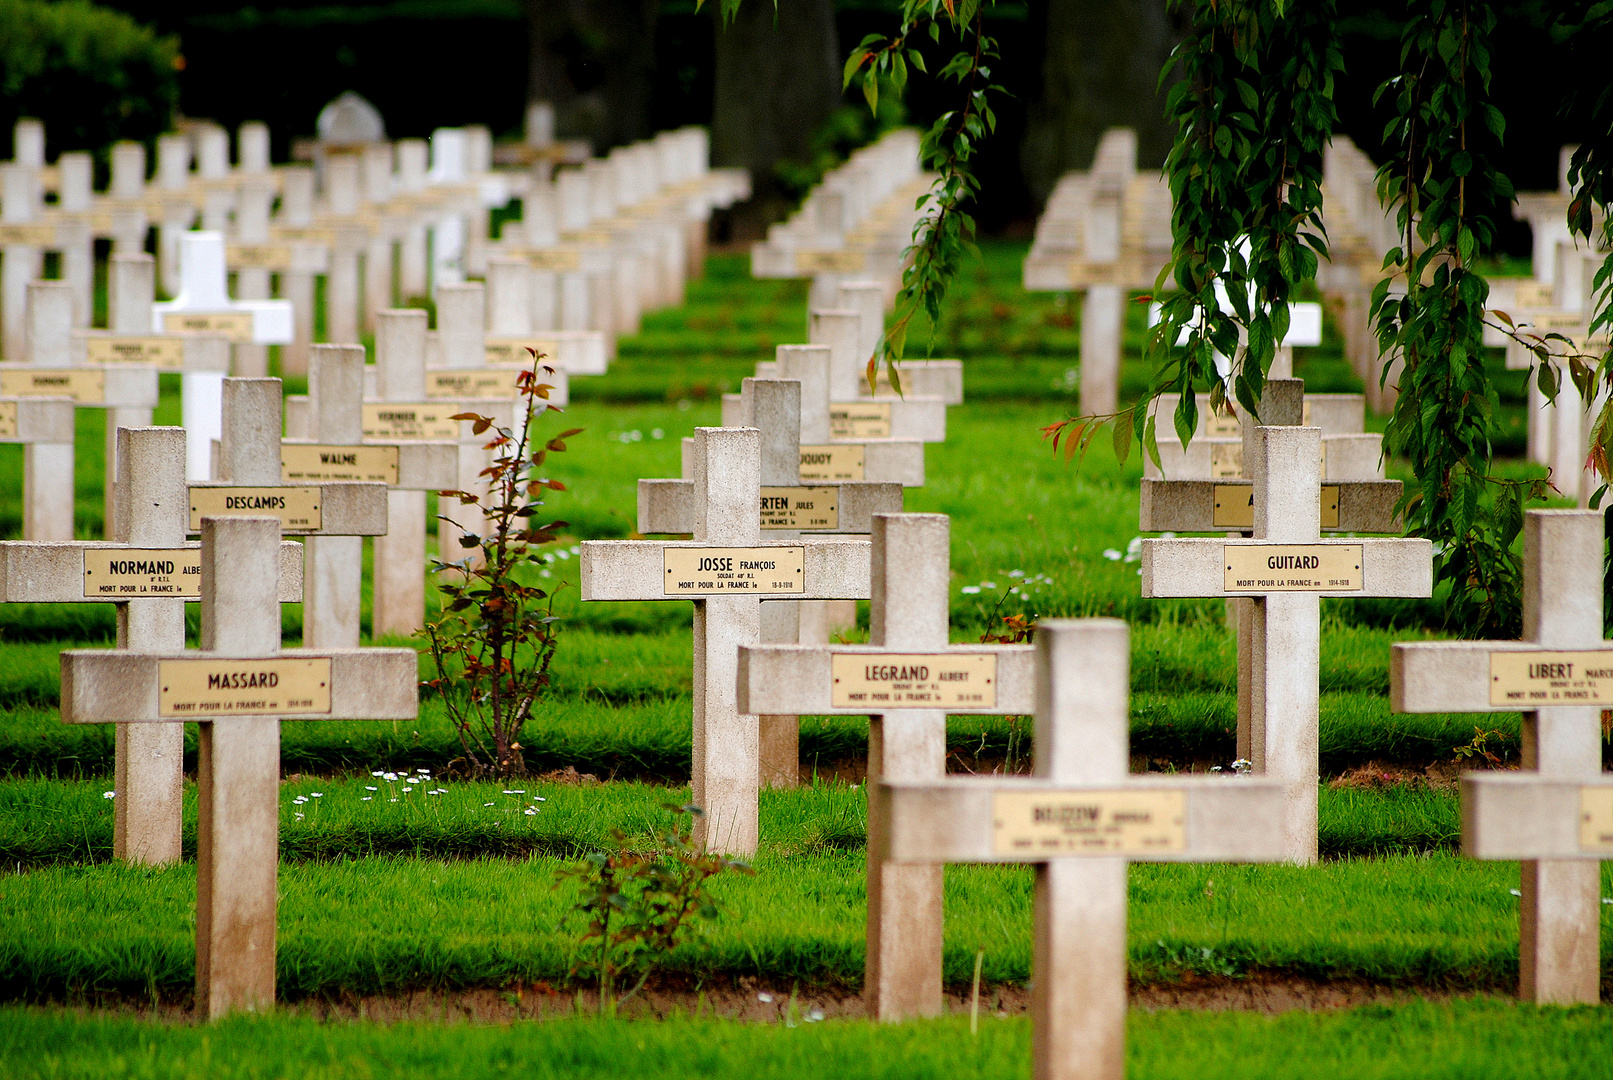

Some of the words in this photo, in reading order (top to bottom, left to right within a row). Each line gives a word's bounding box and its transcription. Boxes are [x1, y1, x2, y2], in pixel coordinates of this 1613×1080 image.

[320, 453, 357, 465] WALME
[226, 496, 286, 509] DESCAMPS
[795, 501, 814, 510] JULES
[109, 560, 175, 575] NORMAND
[697, 557, 733, 571] JOSSE
[739, 561, 776, 571] FRANÇOIS
[1267, 555, 1319, 570] GUITARD
[678, 581, 695, 589] MORT
[698, 581, 714, 589] POUR
[717, 581, 725, 589] LA
[728, 581, 749, 589] FRANCE
[752, 581, 758, 589] le
[865, 666, 929, 681] LEGRAND
[938, 672, 969, 682] ALBERT
[1529, 663, 1574, 679] LIBERT
[207, 672, 279, 690] MASSARD
[1507, 691, 1525, 699] MORT
[1529, 691, 1547, 699] POUR
[173, 702, 196, 711] MORT
[199, 702, 221, 711] POUR
[223, 701, 233, 710] LA
[236, 701, 266, 709] FRANCE
